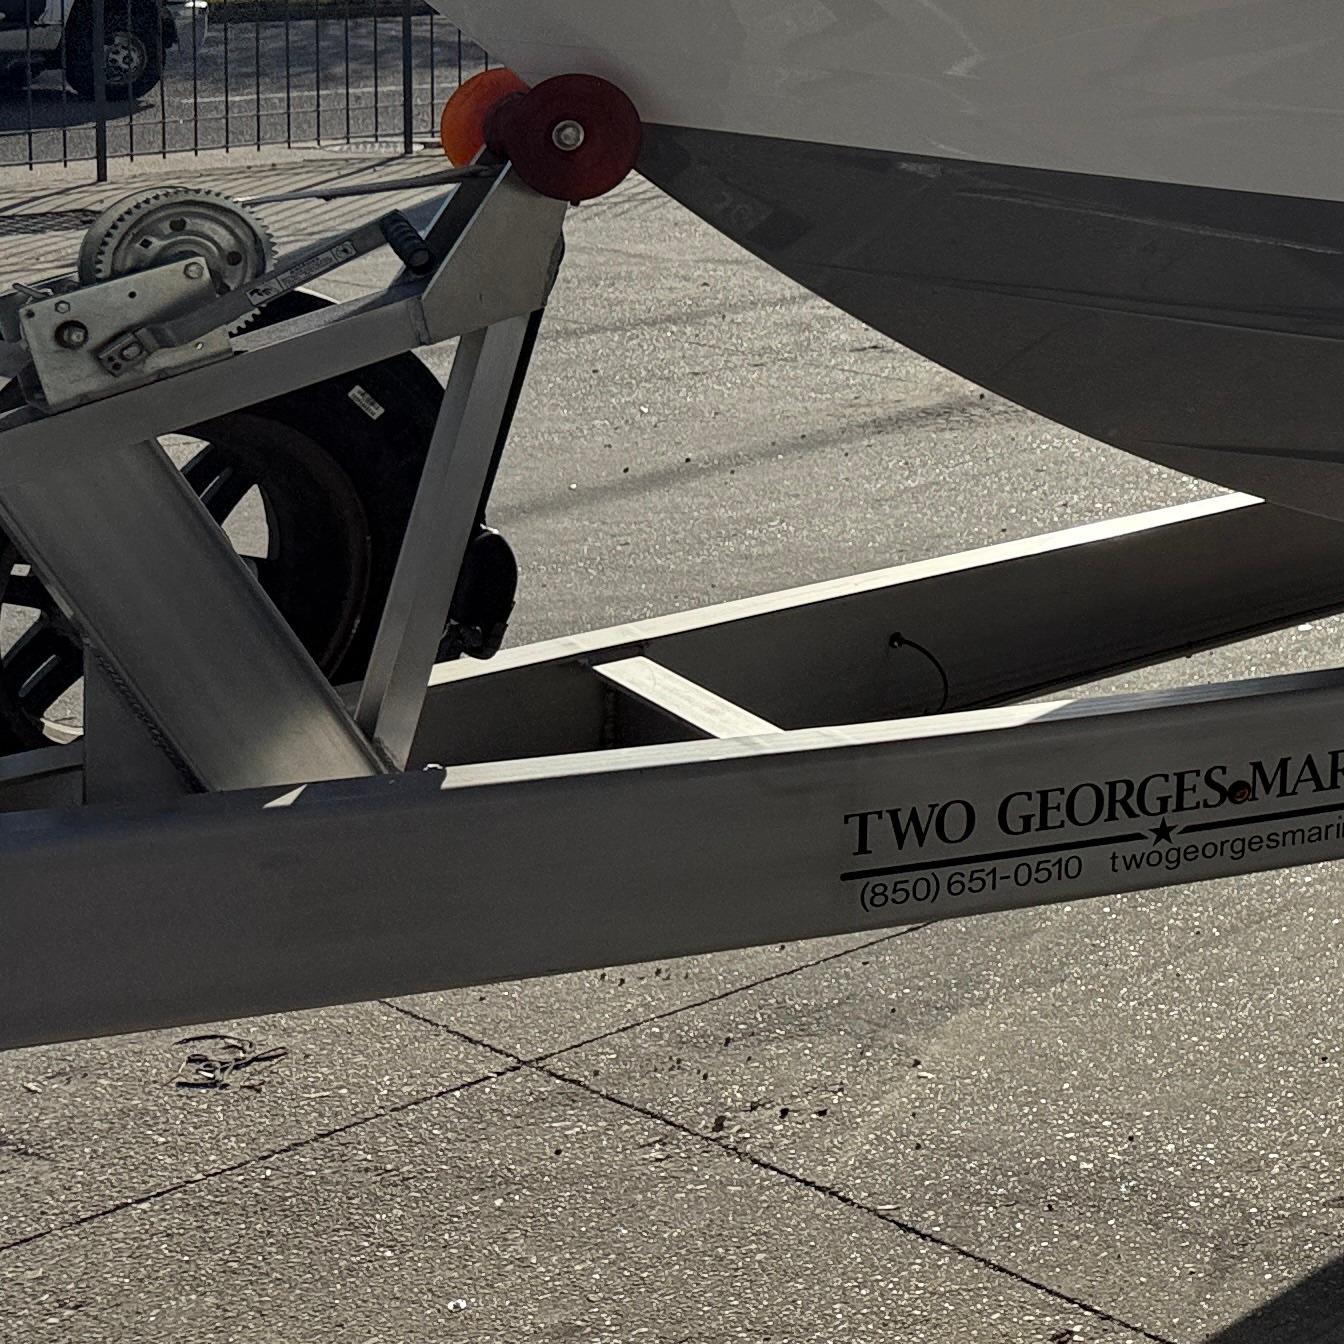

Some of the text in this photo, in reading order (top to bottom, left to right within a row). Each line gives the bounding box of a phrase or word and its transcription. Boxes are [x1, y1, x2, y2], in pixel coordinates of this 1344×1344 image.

[843, 798, 976, 856] TWO
[997, 764, 1228, 838] GEORGES
[858, 877, 941, 914] (850)
[947, 855, 1083, 898] 651-0510
